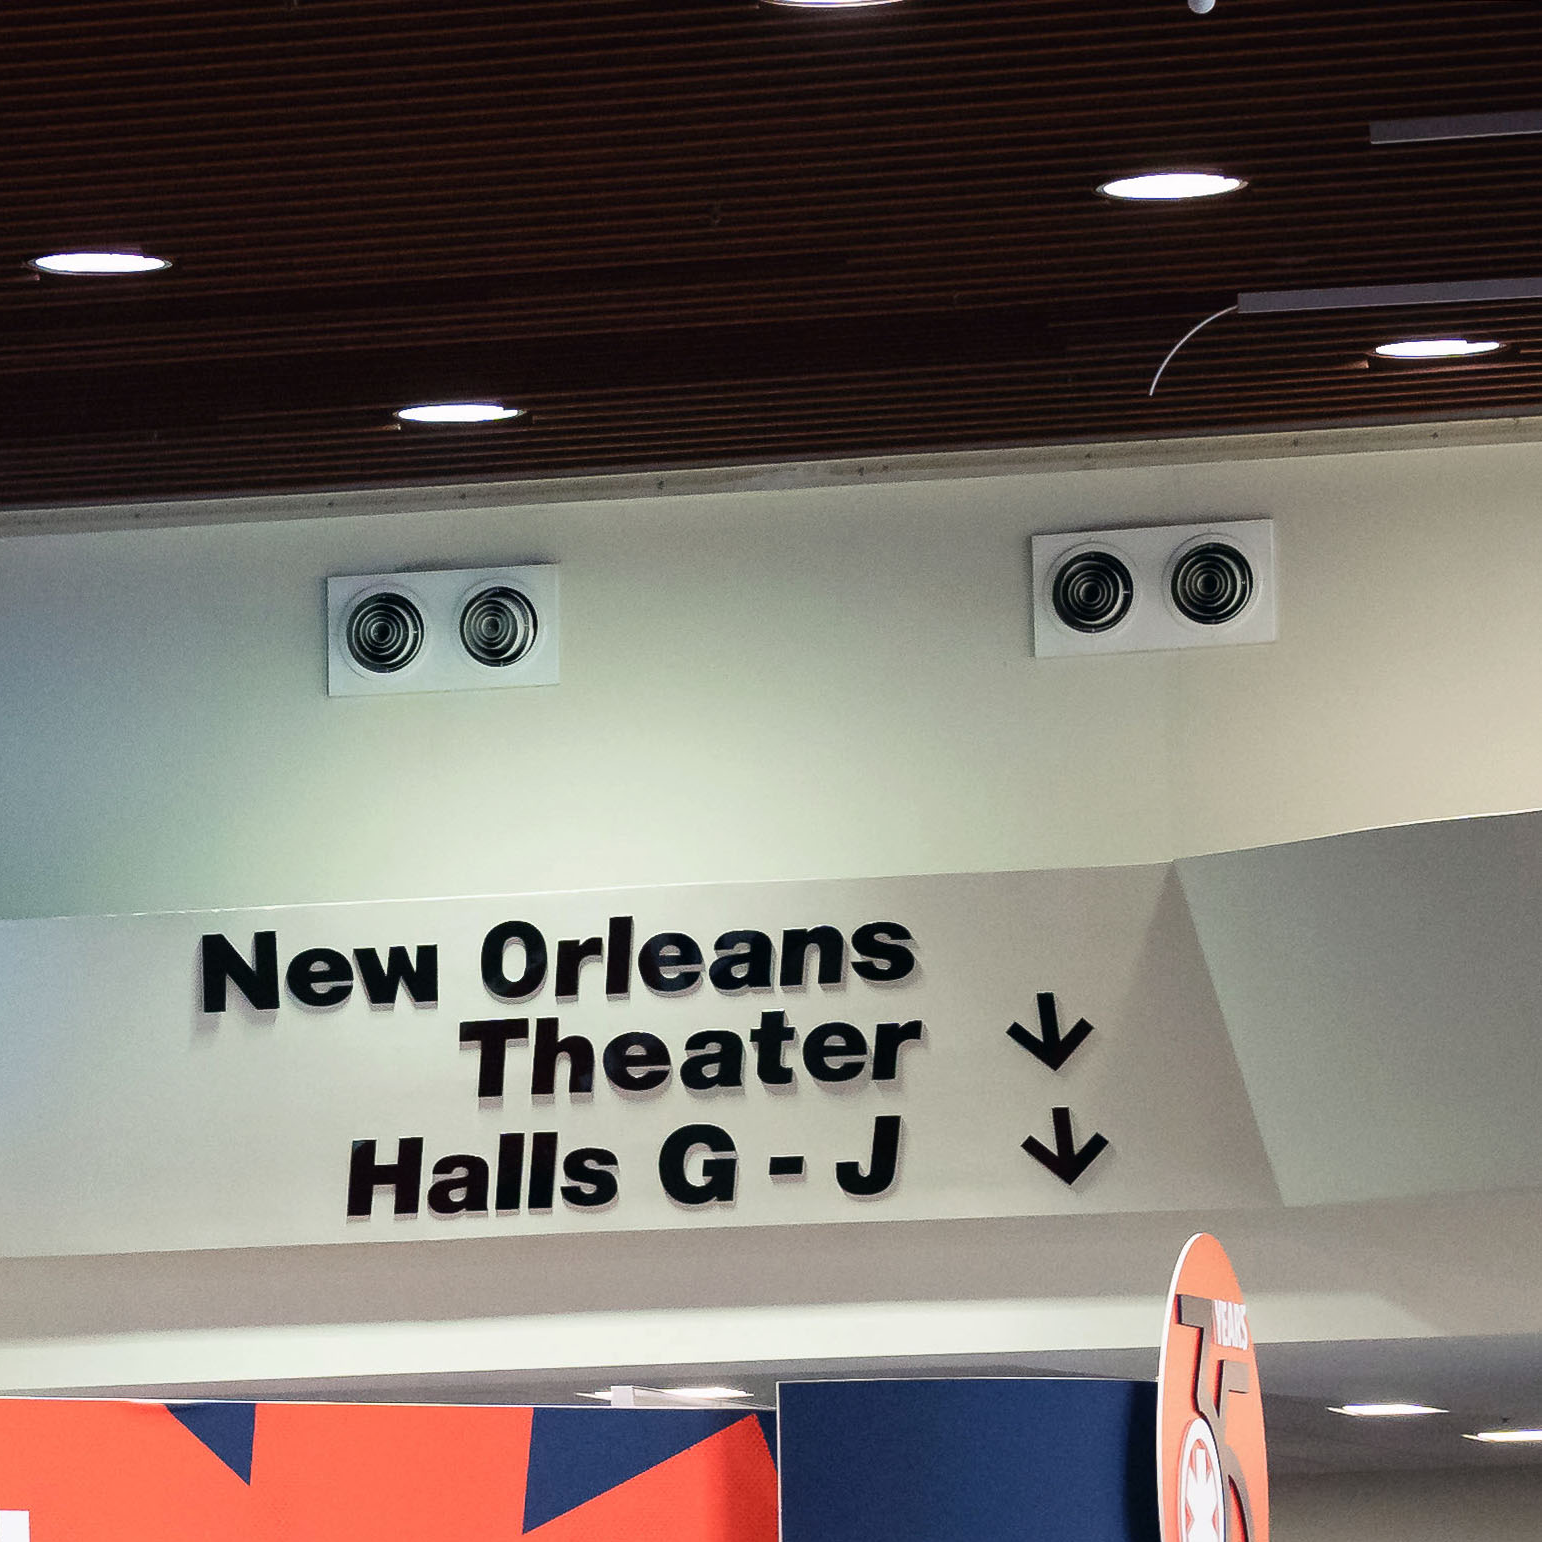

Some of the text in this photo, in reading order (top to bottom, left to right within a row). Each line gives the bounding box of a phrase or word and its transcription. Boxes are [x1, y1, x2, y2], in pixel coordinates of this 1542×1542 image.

[201, 915, 915, 1013] New Orleans
[458, 1009, 921, 1100] Theater
[346, 1114, 902, 1219] Halls G - J
[1213, 1299, 1248, 1351] YEARS
